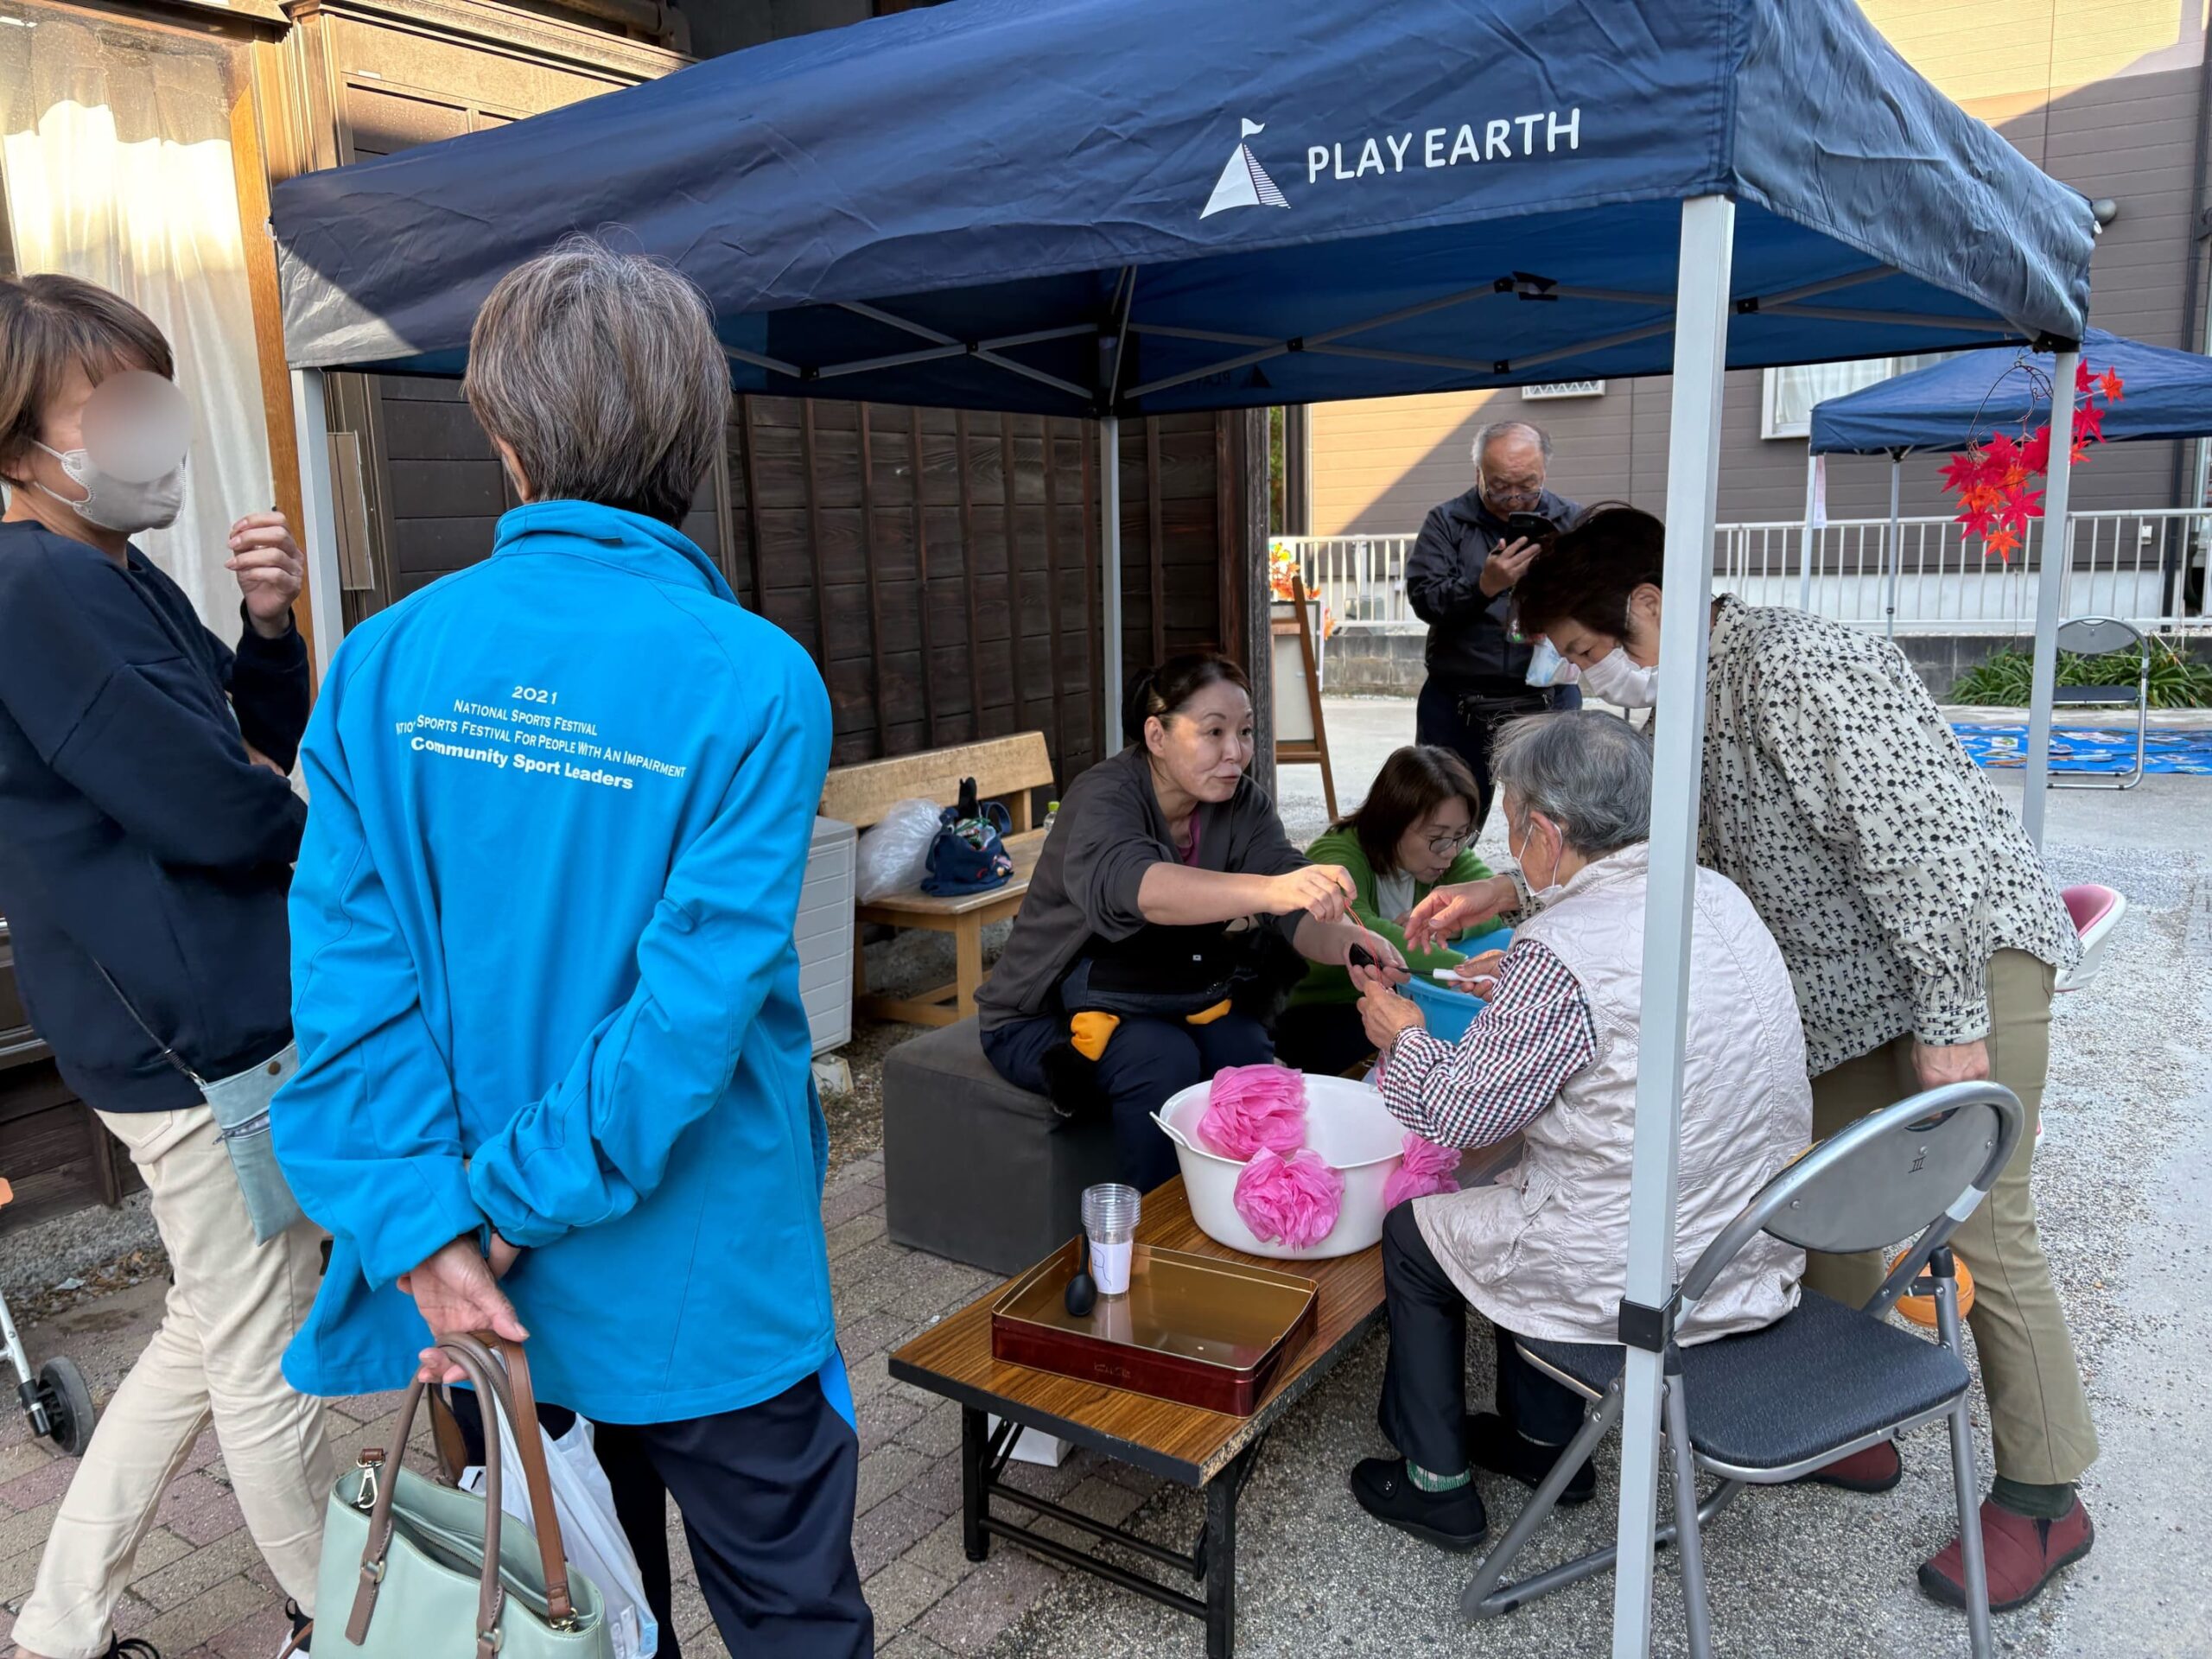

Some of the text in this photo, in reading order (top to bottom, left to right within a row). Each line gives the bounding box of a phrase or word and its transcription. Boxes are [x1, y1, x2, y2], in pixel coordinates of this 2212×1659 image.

[1308, 107, 1580, 184] PLAY EARTH
[454, 699, 598, 736] NATIONAL SPORTS FESTIVAL
[511, 685, 558, 705] 2021
[410, 736, 633, 790] Community Sport Leaders
[416, 715, 458, 733] SPORTS
[461, 721, 511, 742] FESTIVAL
[514, 730, 536, 747] FOR
[538, 734, 576, 753] PEOPLE
[577, 741, 601, 759] WITH
[603, 747, 621, 762] AN
[623, 751, 687, 778] IMPAIRMENT
